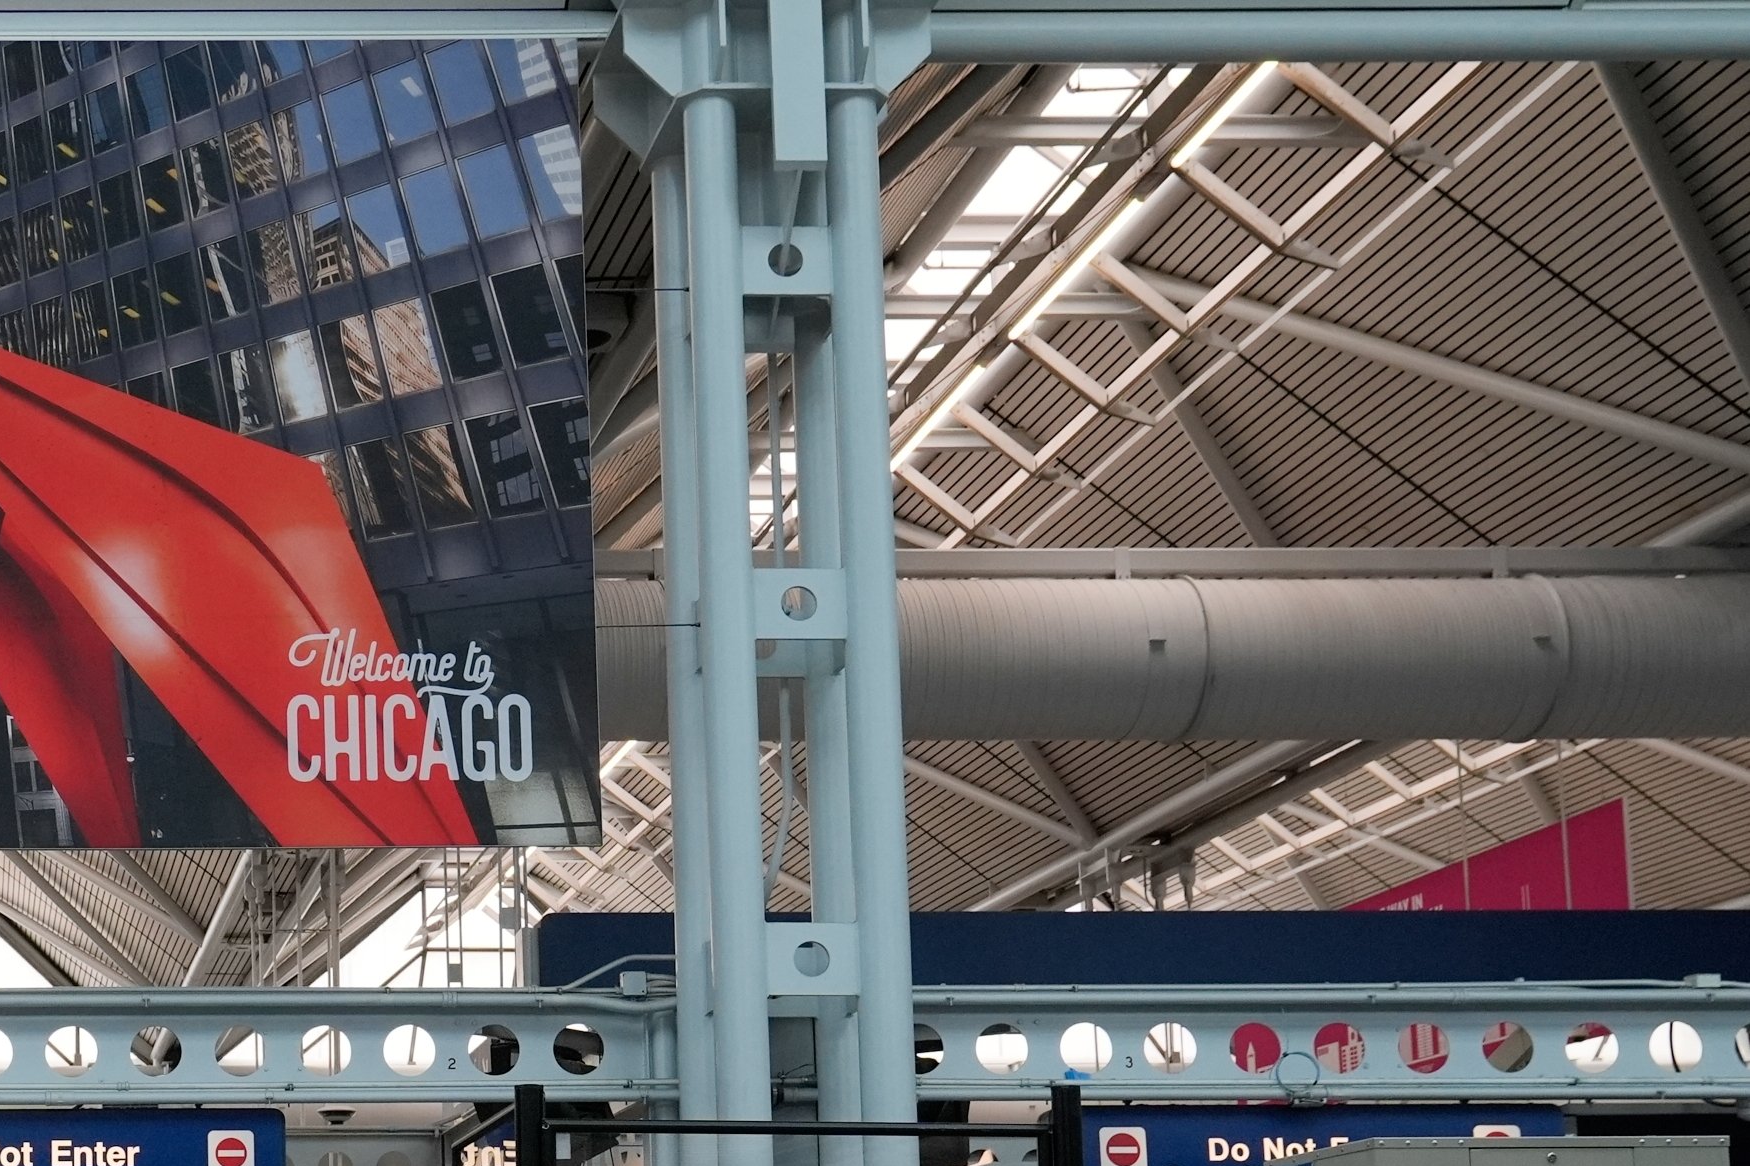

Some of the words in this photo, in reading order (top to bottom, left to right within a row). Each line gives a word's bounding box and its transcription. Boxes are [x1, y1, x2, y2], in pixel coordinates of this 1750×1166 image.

[288, 627, 457, 687] Welcome
[286, 694, 533, 783] CHICAGO
[447, 1057, 456, 1070] 2
[1125, 1056, 1133, 1069] 3
[1207, 1137, 1250, 1163] Do
[1262, 1137, 1317, 1163] Not
